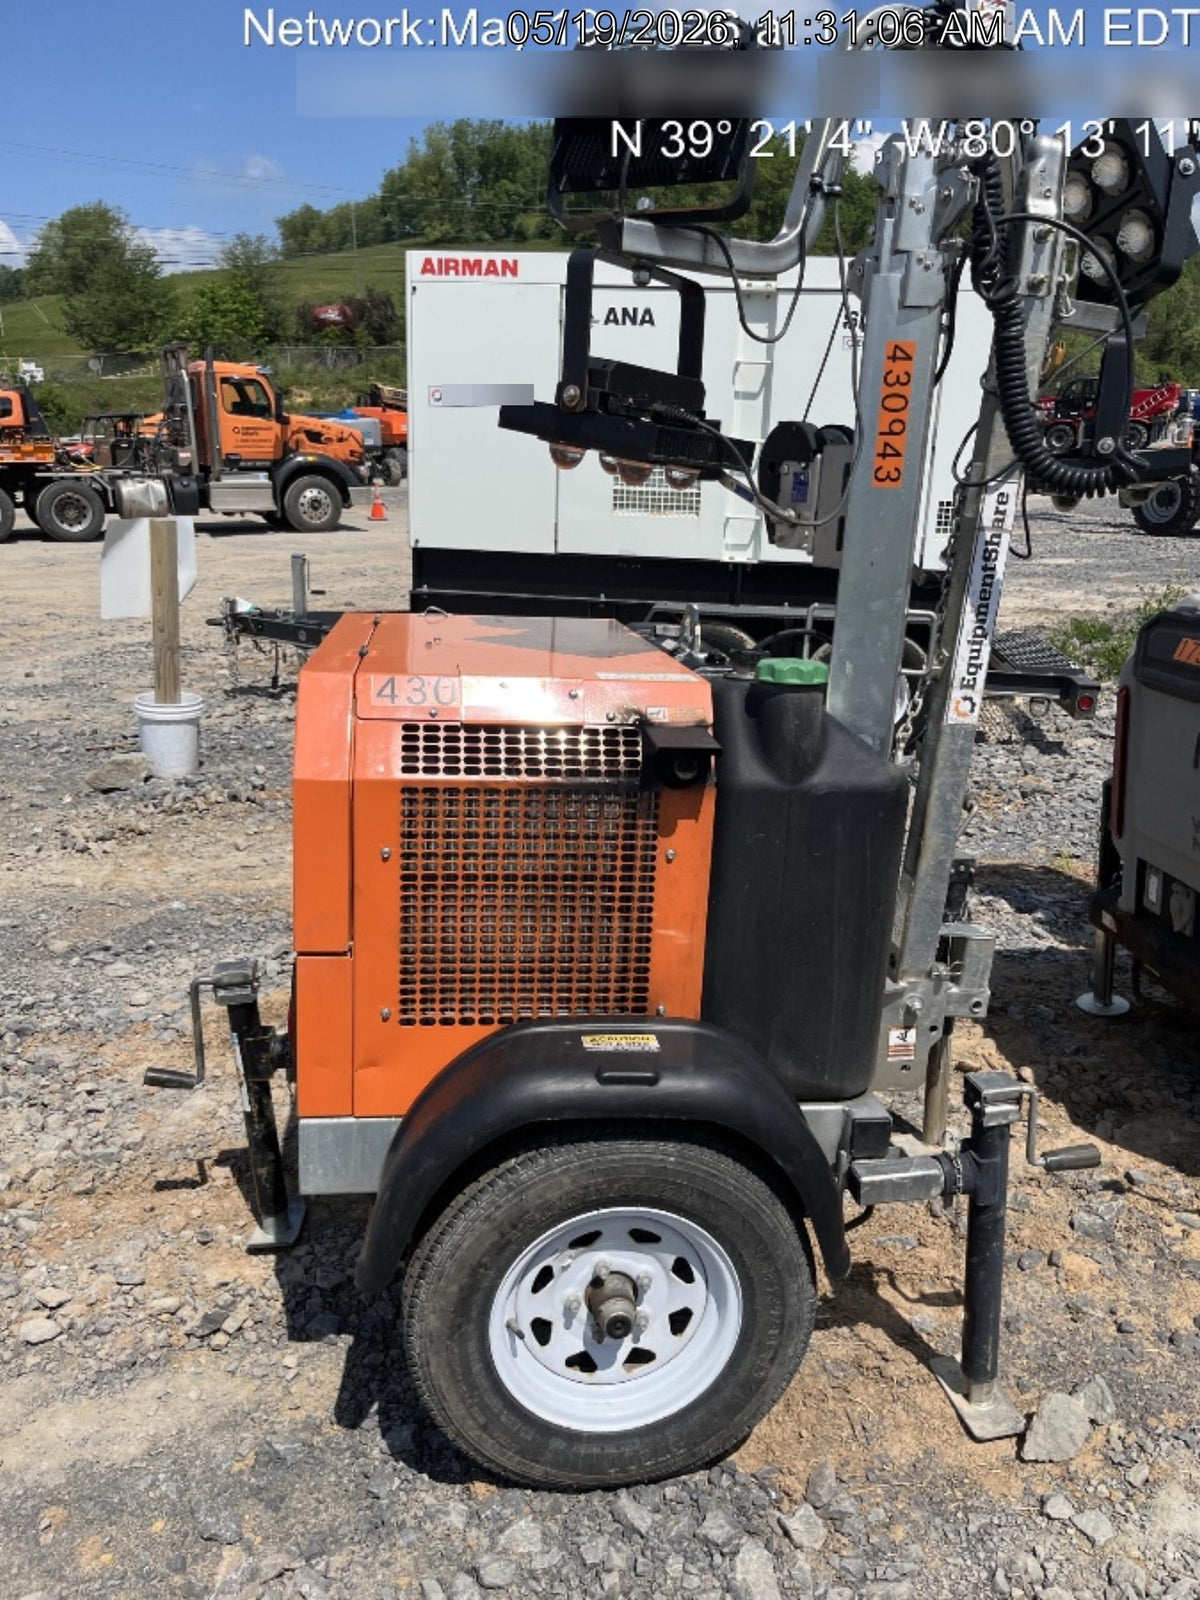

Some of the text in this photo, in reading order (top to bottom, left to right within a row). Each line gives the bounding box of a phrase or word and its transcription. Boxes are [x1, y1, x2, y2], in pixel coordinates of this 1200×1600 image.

[420, 257, 519, 278] AIRMAN
[603, 306, 656, 327] ANA
[873, 343, 914, 484] 430943
[958, 490, 1011, 692] EquipmentShare
